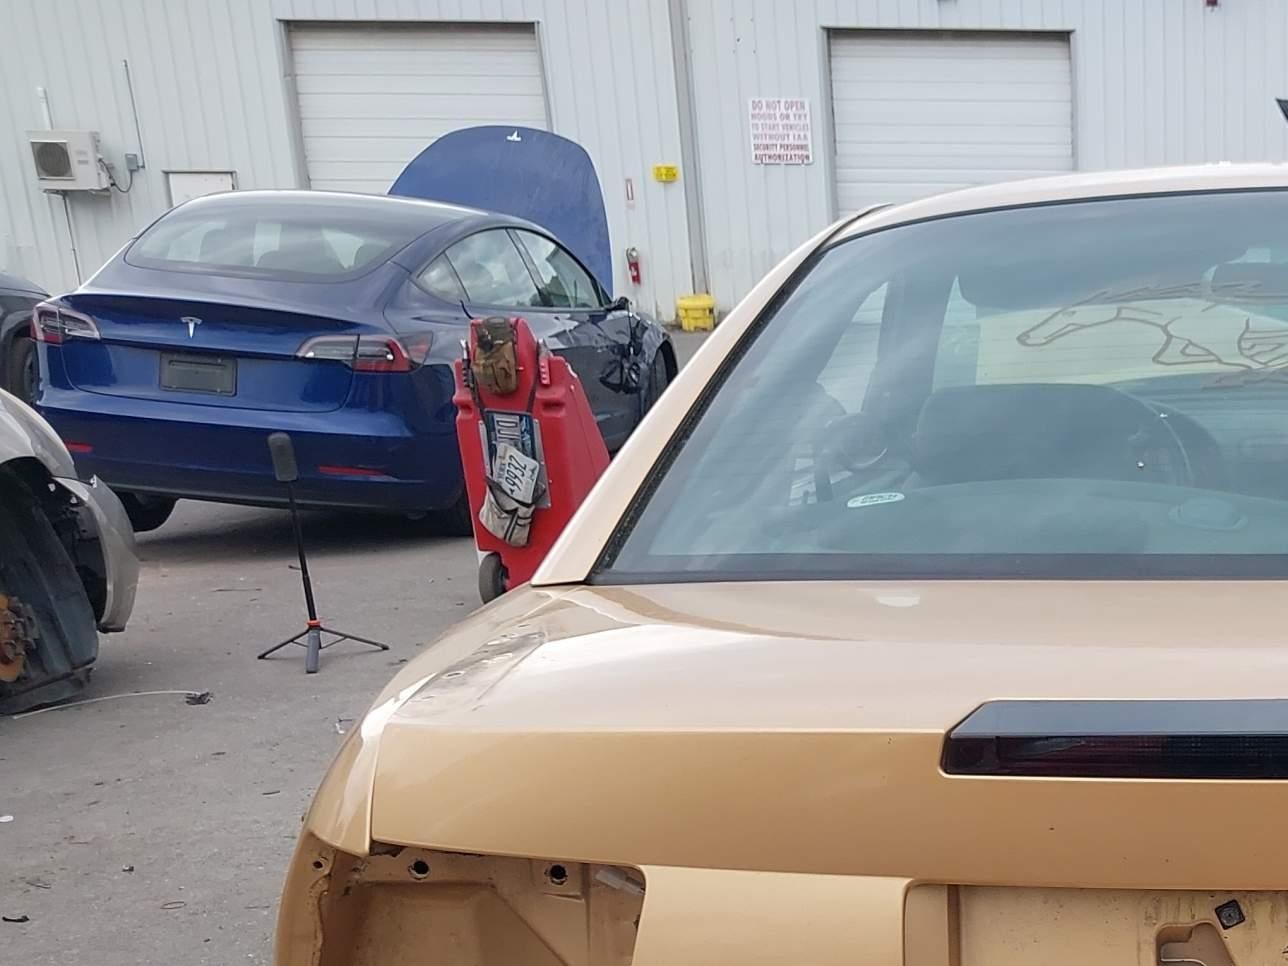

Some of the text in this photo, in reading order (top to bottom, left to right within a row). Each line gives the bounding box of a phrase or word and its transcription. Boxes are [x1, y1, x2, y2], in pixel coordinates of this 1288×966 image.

[752, 100, 805, 111] DO NOT OPEN
[751, 113, 807, 121] HOODS OR TRY
[753, 133, 790, 141] WITHOUT
